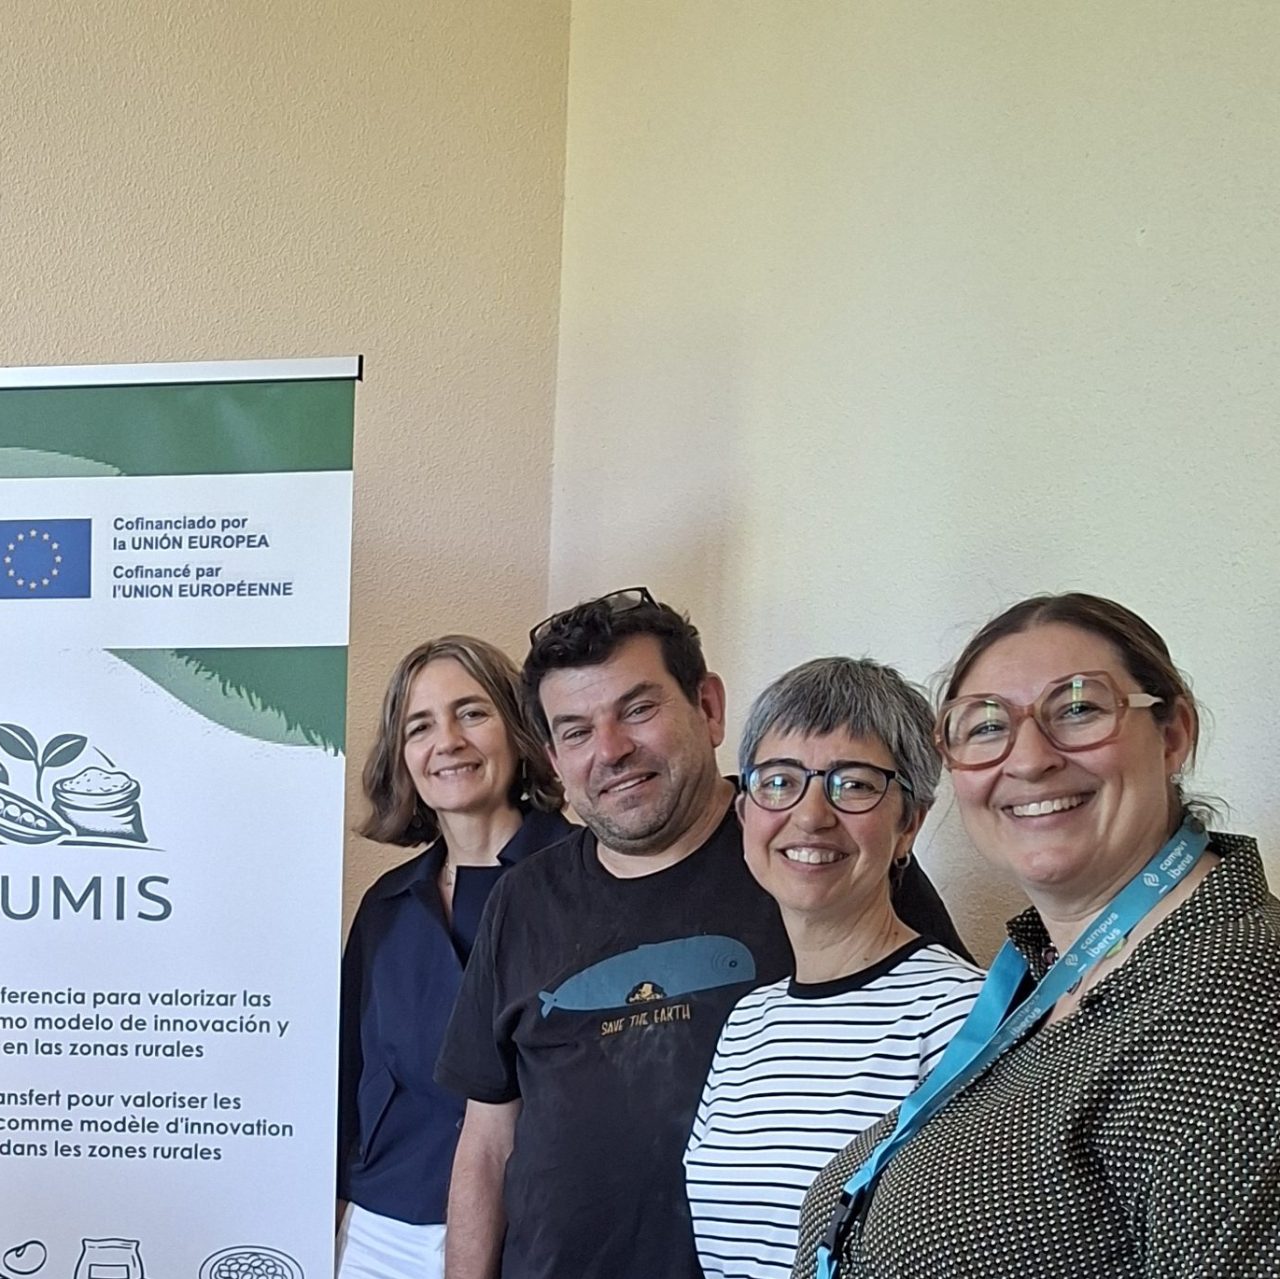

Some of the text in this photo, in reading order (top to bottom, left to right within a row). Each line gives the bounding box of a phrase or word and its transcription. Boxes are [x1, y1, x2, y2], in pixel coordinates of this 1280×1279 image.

[113, 515, 249, 533] Cofinanciado por
[113, 532, 270, 551] la UNIÓN EUROPEA
[112, 563, 222, 582] Cofinancé par
[178, 580, 293, 598] EUROPÉENNE
[1080, 912, 1119, 950] campus
[1086, 928, 1121, 958] iberus
[92, 992, 143, 1009] para
[147, 988, 237, 1007] valorizar
[242, 989, 272, 1008] las
[34, 1013, 114, 1031] modelo
[119, 1014, 147, 1032] de
[153, 1013, 271, 1034] innovación
[276, 1020, 290, 1038] y
[601, 1003, 691, 1036] SAVE THE EARTH
[2, 1041, 28, 1055] en
[34, 1038, 63, 1056] las
[68, 1043, 129, 1057] zonas
[134, 1040, 204, 1058] rurales
[67, 1093, 115, 1111] pour
[120, 1091, 208, 1109] valoriser
[213, 1092, 242, 1110] les
[79, 1114, 160, 1134] modèle
[165, 1117, 295, 1137] d'innovation
[54, 1139, 82, 1158] les
[87, 1144, 147, 1159] zones
[152, 1142, 222, 1161] rurales
